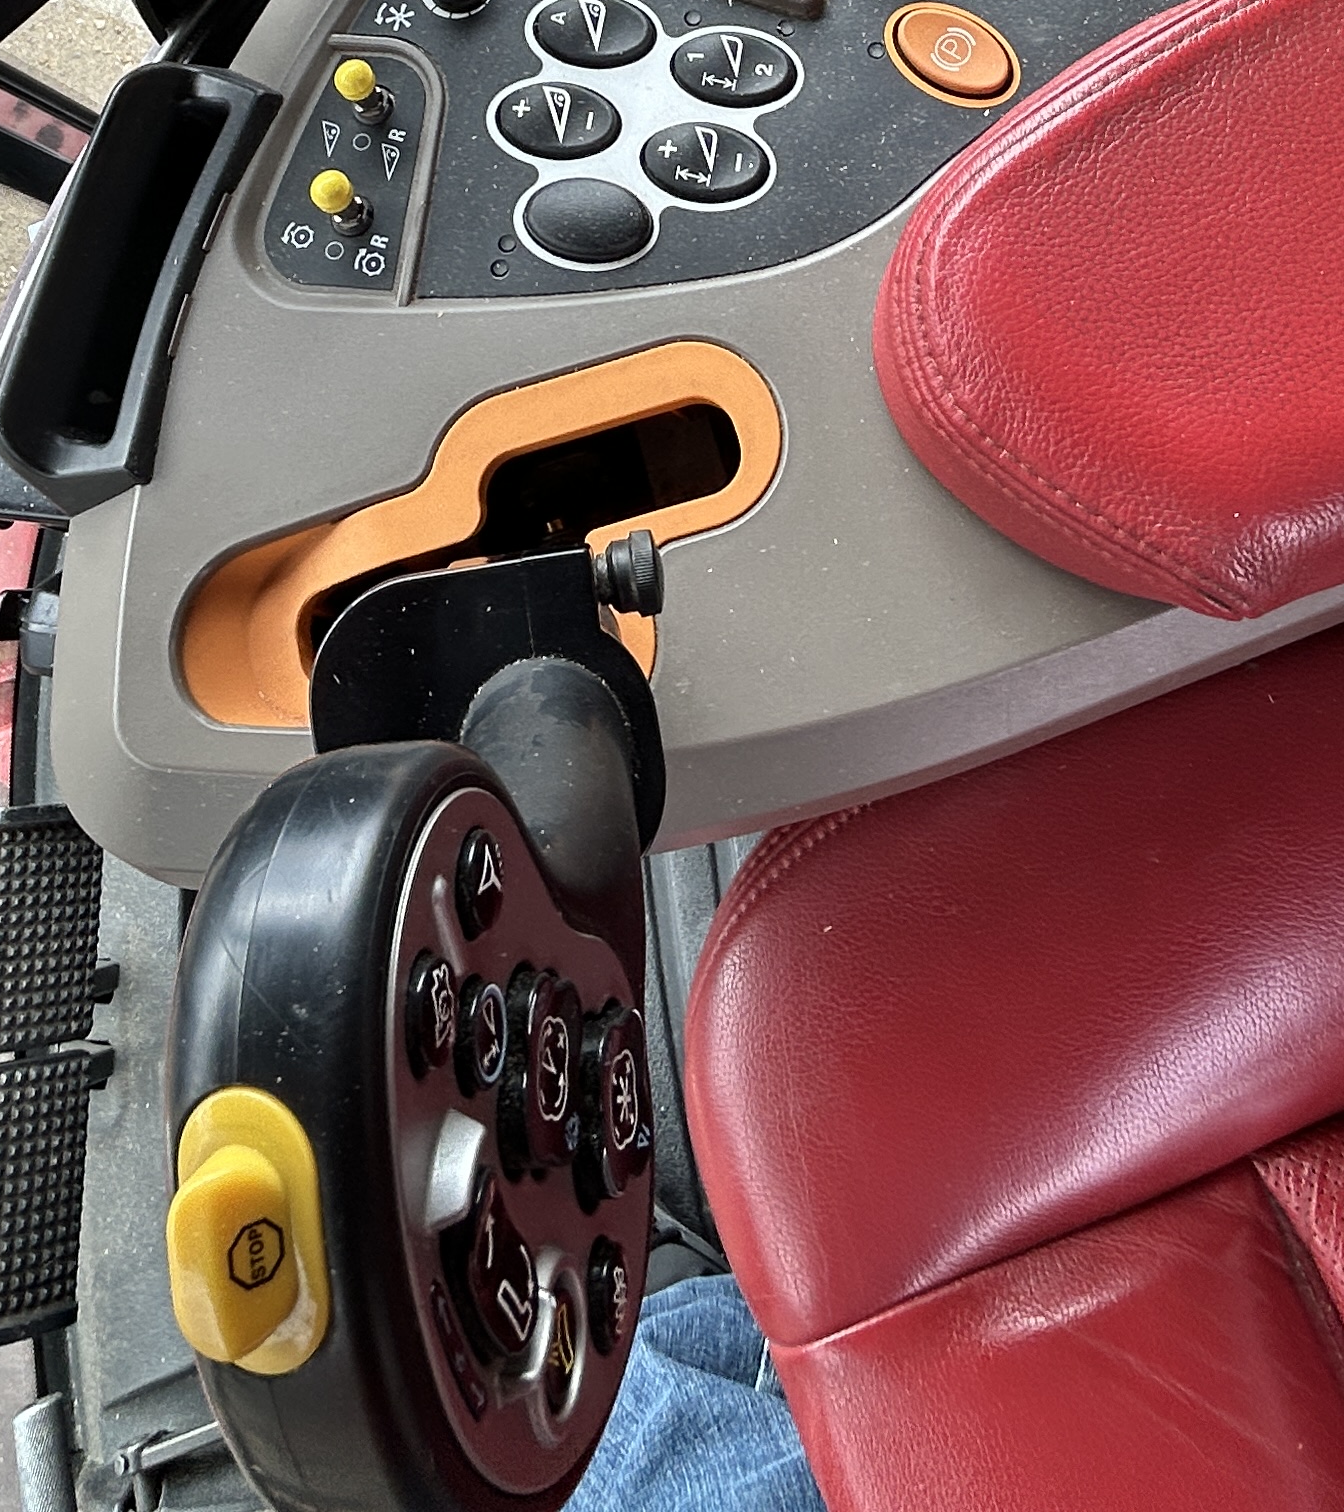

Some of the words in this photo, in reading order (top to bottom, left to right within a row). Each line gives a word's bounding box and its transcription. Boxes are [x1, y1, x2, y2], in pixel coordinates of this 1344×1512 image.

[550, 11, 567, 25] A
[940, 38, 962, 60] P
[686, 51, 705, 63] 1
[754, 63, 774, 77] 2
[388, 128, 407, 143] R
[369, 234, 389, 249] R
[247, 1228, 266, 1281] STOP
